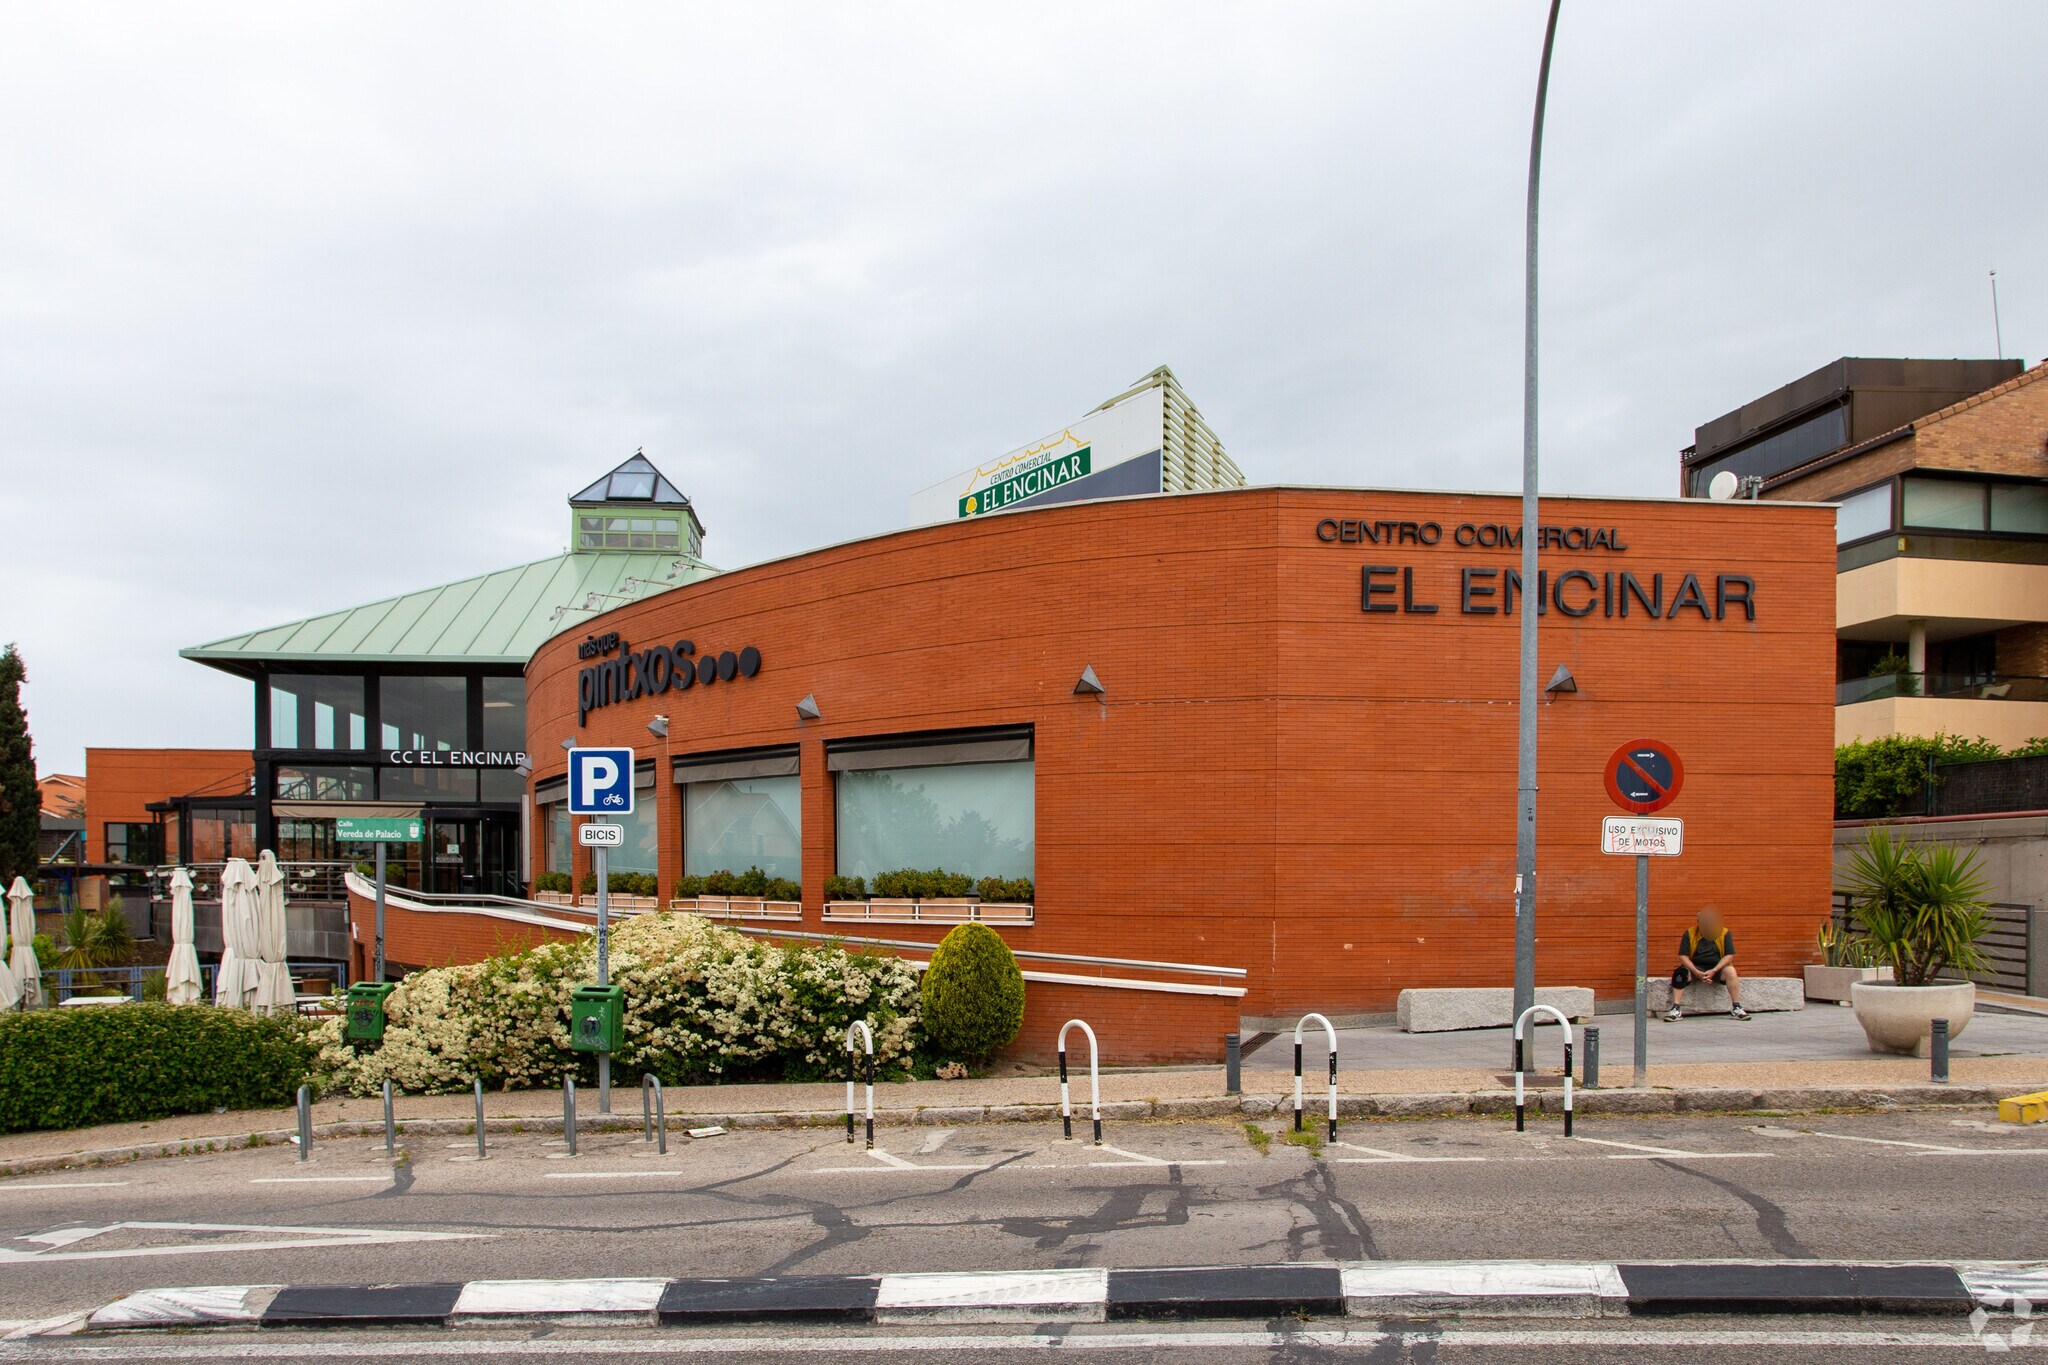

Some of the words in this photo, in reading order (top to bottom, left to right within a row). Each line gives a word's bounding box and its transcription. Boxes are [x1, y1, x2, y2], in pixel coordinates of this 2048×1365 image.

[990, 467, 1014, 485] CENTRO
[1014, 451, 1052, 475] COMERCIAL
[983, 488, 1000, 512] EL
[1003, 455, 1082, 504] ENCINAR
[1316, 518, 1443, 545] CENTRO
[1361, 565, 1439, 613] EL
[1462, 568, 1756, 620] ENCINAR
[390, 750, 413, 764] CC
[420, 751, 443, 765] EL
[450, 751, 526, 765] ENCINAR
[581, 756, 619, 806] P
[338, 820, 354, 828] Calle
[1608, 825, 1627, 834] USO
[337, 829, 364, 839] Vereda
[364, 829, 375, 839] de
[375, 829, 402, 839] Palacio
[585, 829, 616, 840] BICIS
[1618, 837, 1630, 846] DE
